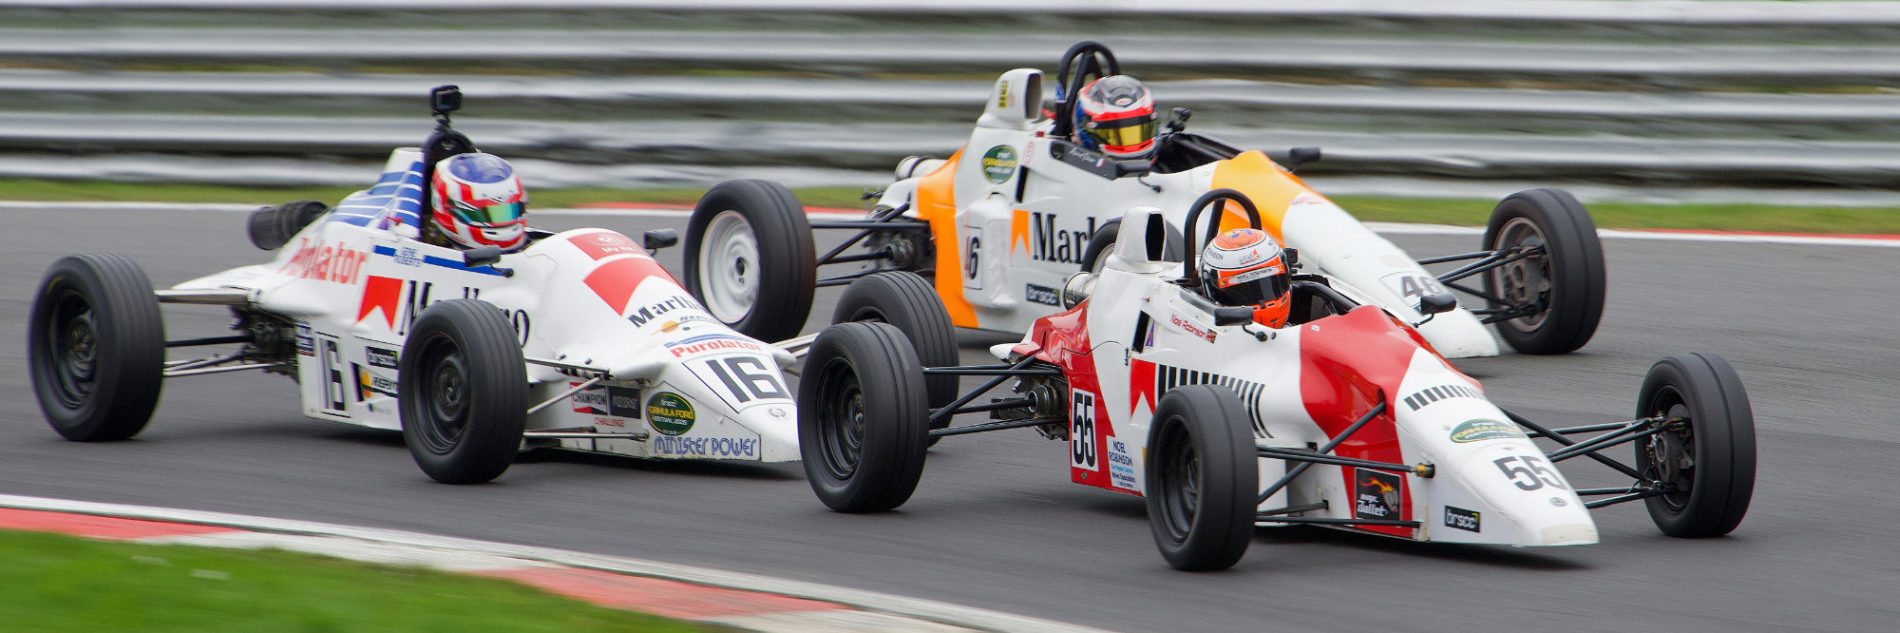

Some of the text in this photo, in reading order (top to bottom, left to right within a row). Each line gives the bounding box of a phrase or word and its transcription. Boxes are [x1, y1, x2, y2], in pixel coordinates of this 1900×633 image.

[670, 339, 762, 358] Purolator
[705, 356, 793, 403] 16
[648, 405, 694, 419] FORMULA FORD
[1073, 391, 1096, 468] 55
[1112, 440, 1127, 454] NOEL
[1108, 451, 1134, 466] ROBINSON
[1492, 455, 1568, 492] 55
[1446, 508, 1477, 529] brscc
